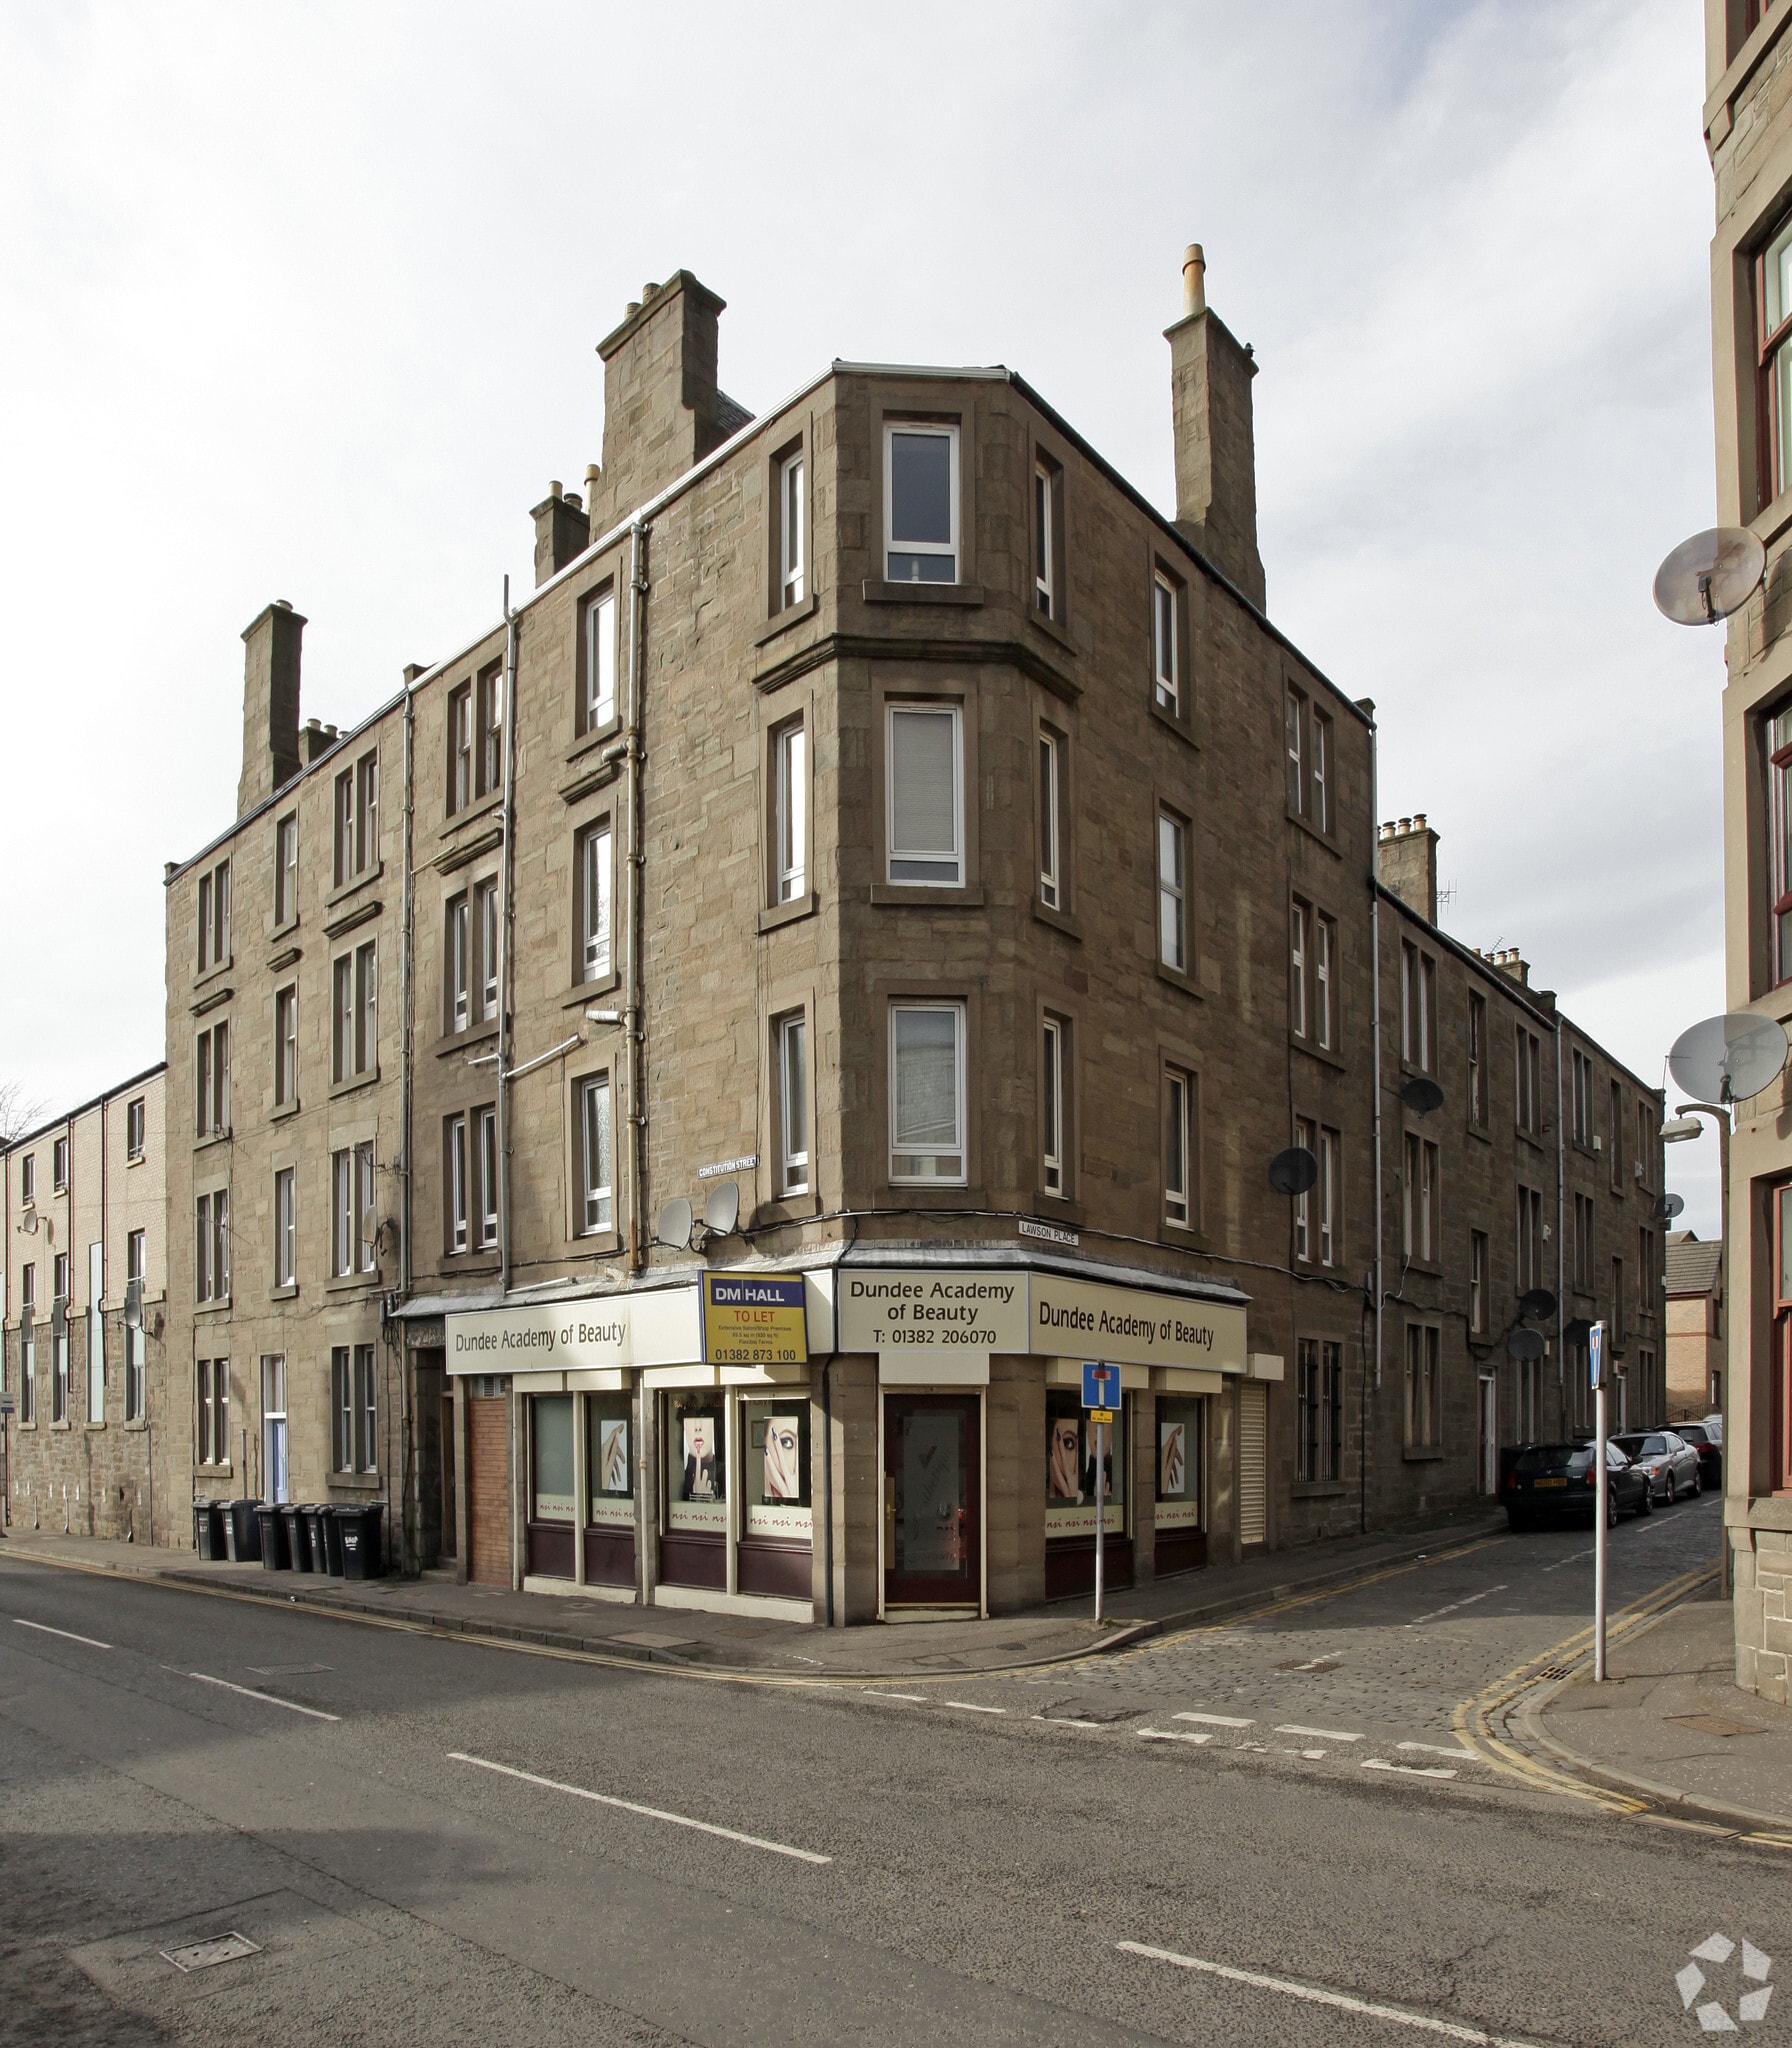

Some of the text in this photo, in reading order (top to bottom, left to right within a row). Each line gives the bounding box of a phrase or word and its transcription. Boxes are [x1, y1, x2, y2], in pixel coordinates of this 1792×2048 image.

[698, 1160, 736, 1177] CONSTITUTION
[1021, 1223, 1075, 1243] LAWSON PLACE
[715, 1287, 785, 1302] DM HALL
[850, 1281, 1015, 1304] Dundee Academy
[734, 1310, 775, 1323] TO LET
[887, 1304, 978, 1325] of Beauty
[1039, 1301, 1214, 1351] Dundee Academy of Beauty
[455, 1322, 627, 1352] Dundee Academy of Beauty
[873, 1329, 997, 1344] T: 01382 206070
[715, 1349, 796, 1361] 01382 873 100
[672, 1510, 688, 1520] nsi
[691, 1512, 708, 1521] nsi
[749, 1515, 768, 1525] nsi
[772, 1516, 791, 1527] nsi
[1046, 1518, 1062, 1529] nsi
[1065, 1517, 1081, 1528] nsi
